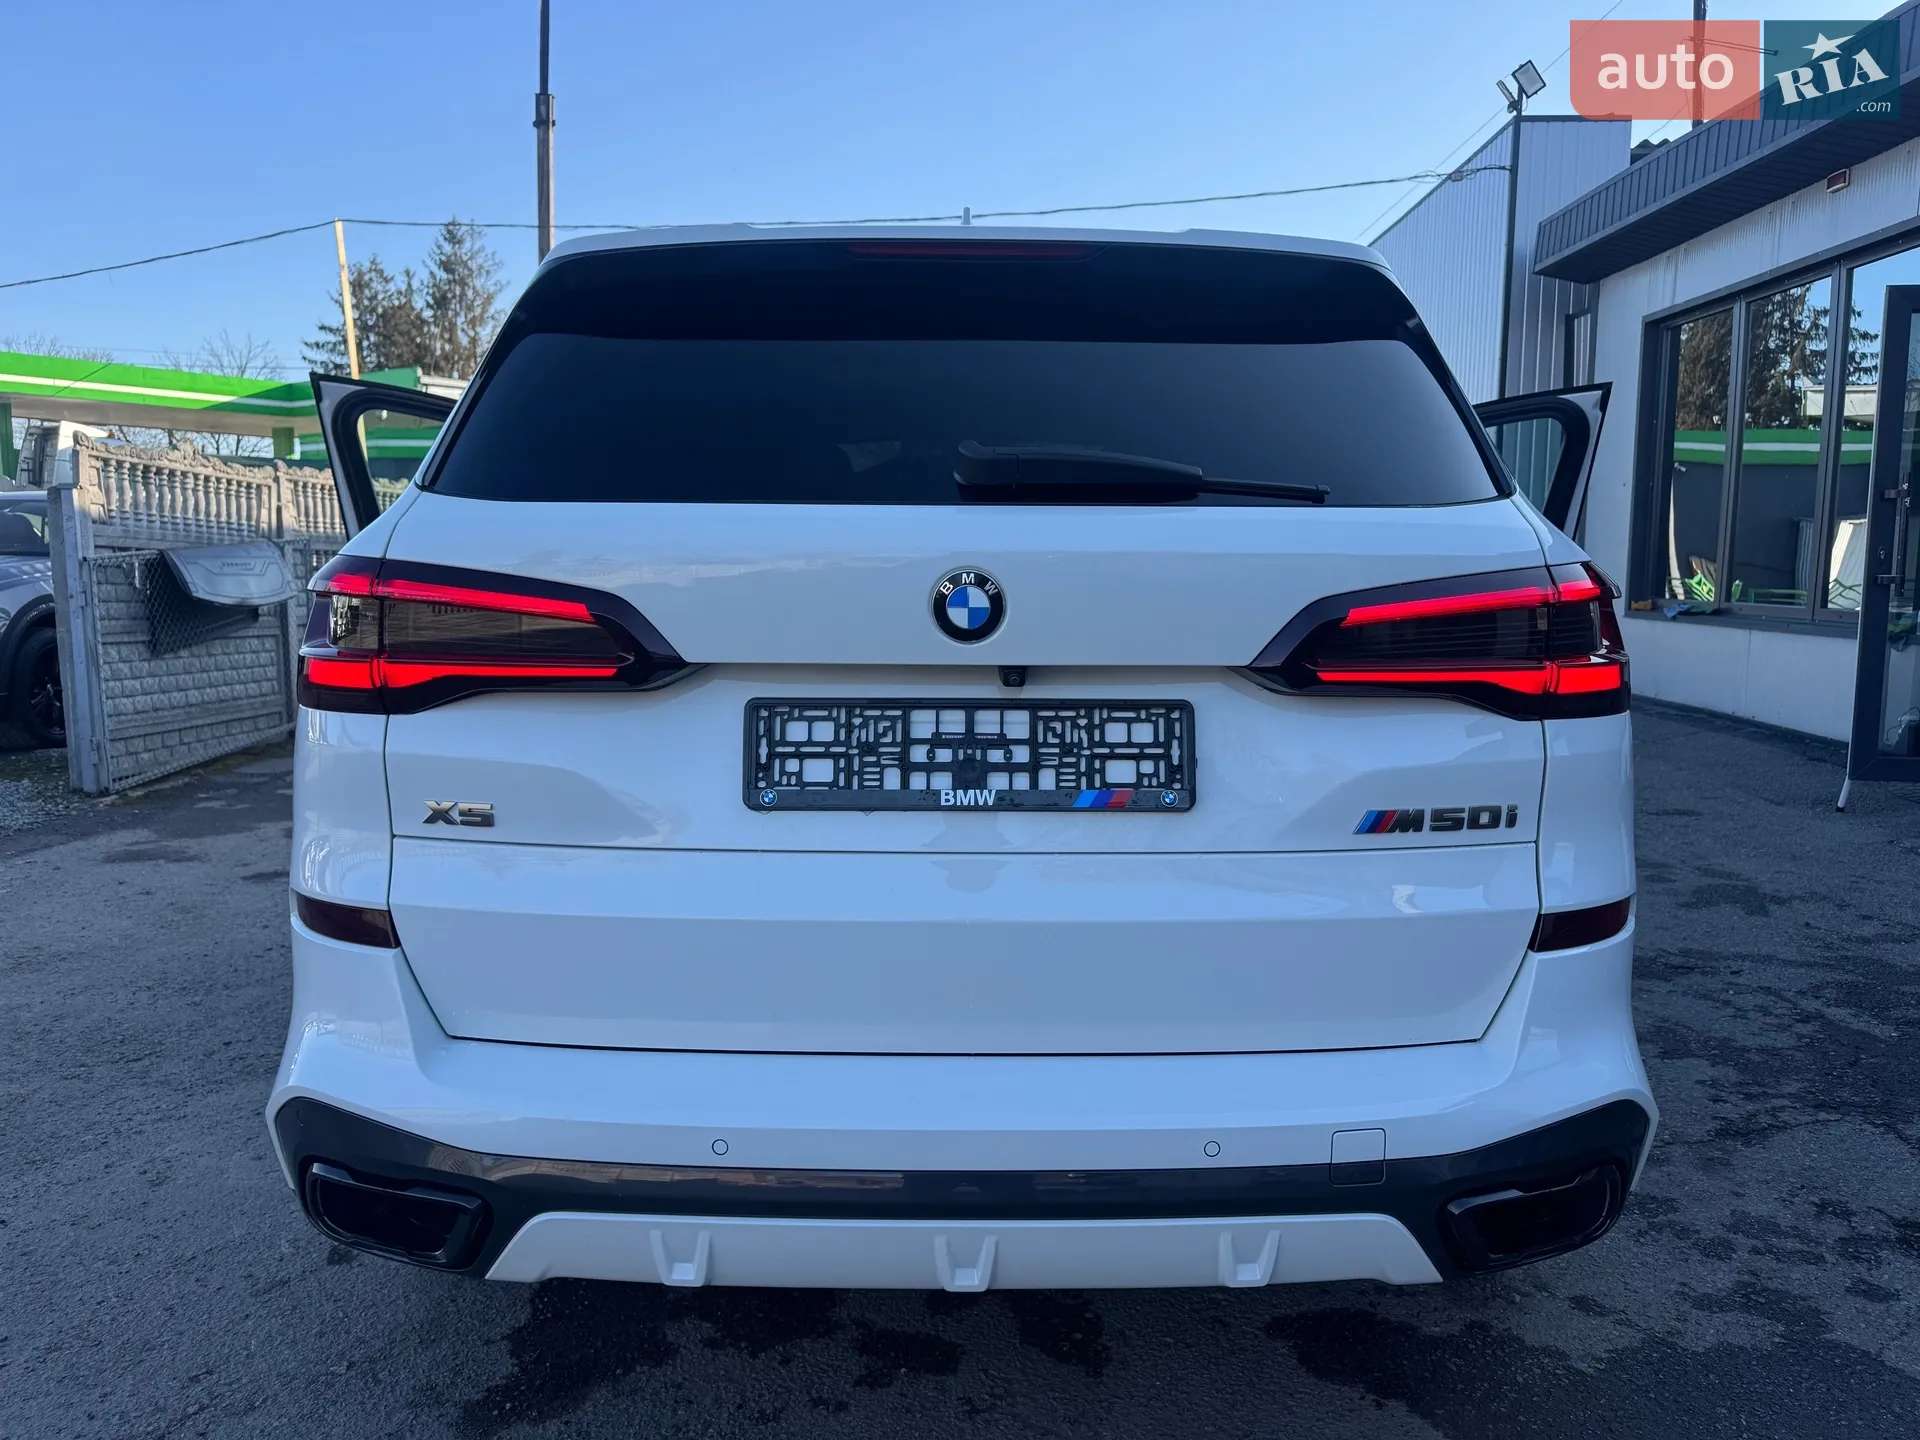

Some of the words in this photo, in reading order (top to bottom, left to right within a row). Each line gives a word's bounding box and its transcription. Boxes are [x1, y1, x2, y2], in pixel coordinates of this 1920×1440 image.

[939, 572, 998, 596] BMW
[940, 789, 996, 806] BMW
[422, 799, 495, 828] X5
